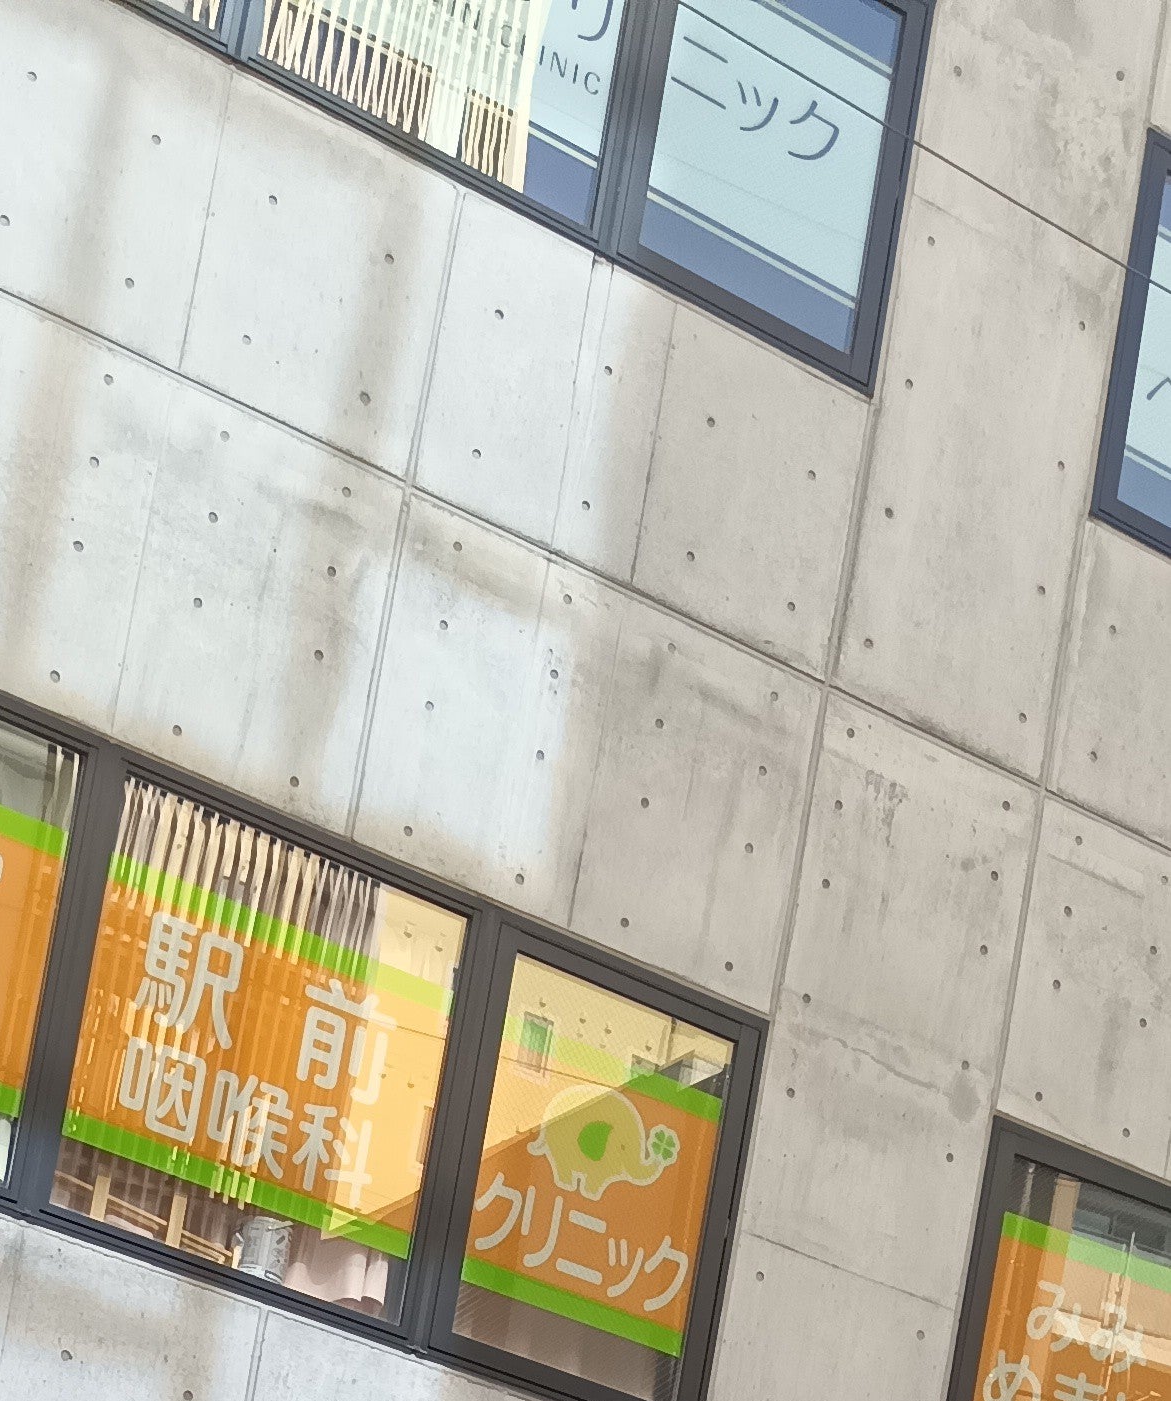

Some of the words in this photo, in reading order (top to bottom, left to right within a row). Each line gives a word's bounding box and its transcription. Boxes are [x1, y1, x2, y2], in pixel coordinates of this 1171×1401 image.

[474, 1172, 689, 1312] クリニック
[1026, 1280, 1149, 1373] みみ
